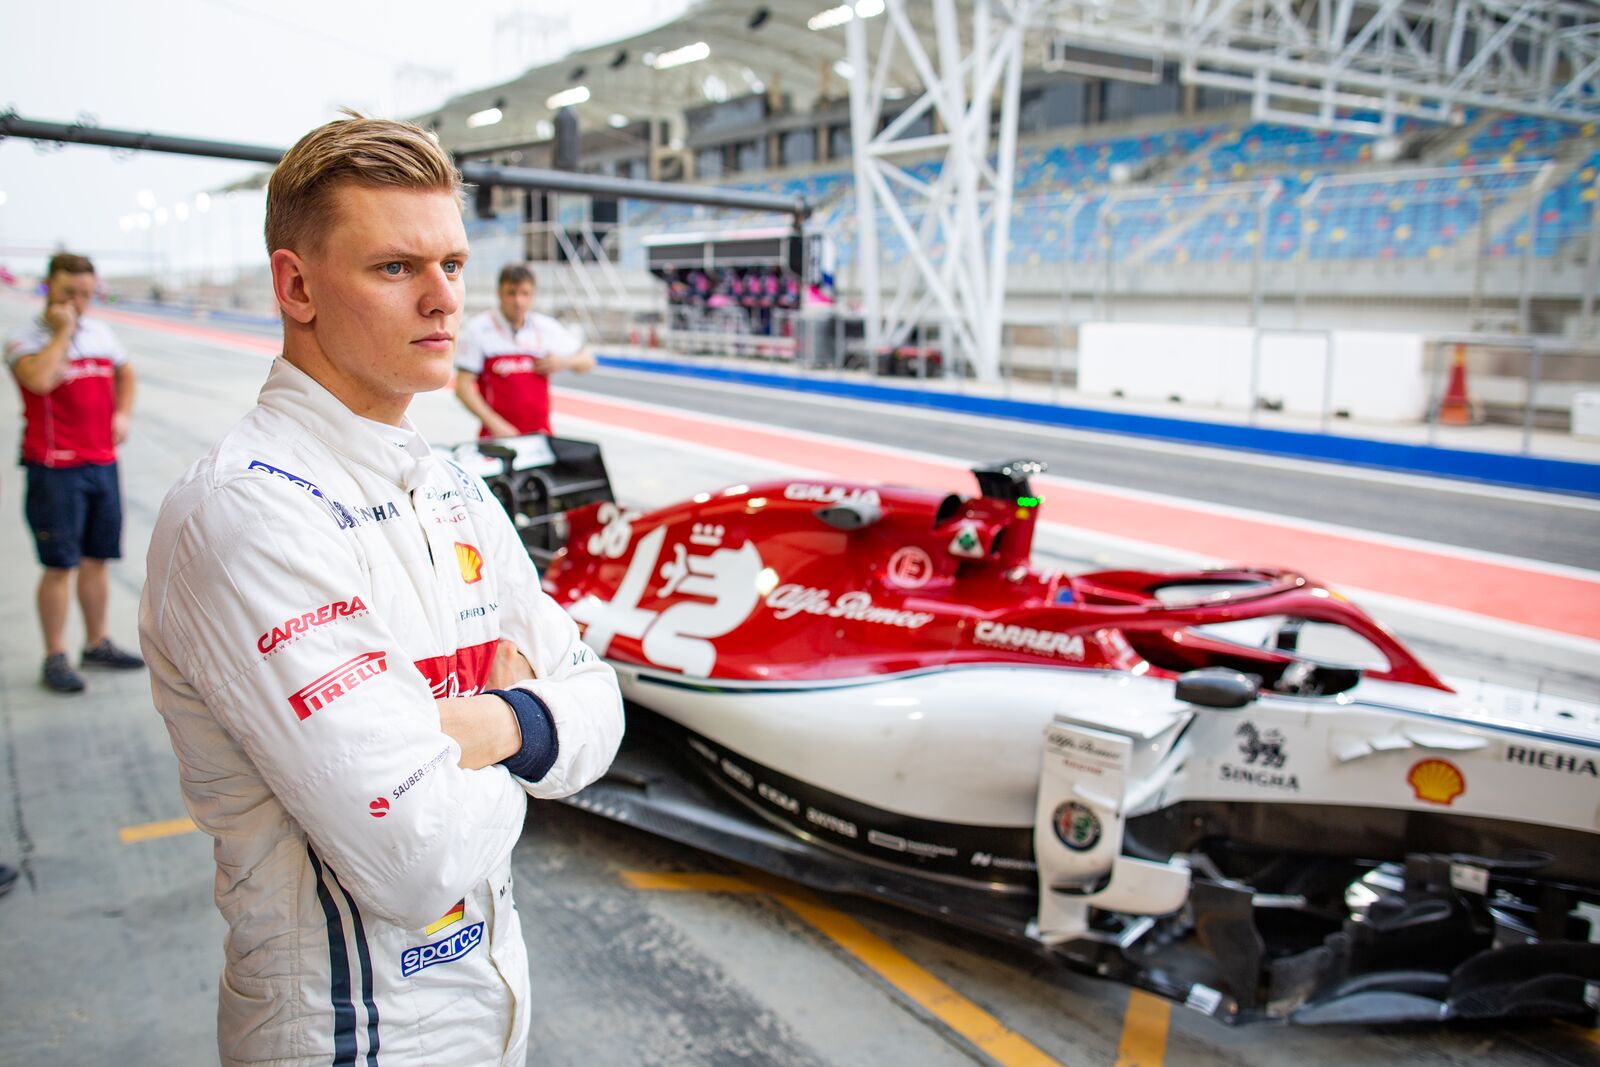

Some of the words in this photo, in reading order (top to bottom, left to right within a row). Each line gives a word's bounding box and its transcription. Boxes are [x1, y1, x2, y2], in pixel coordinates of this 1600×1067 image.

[784, 483, 880, 504] GIULIA
[766, 583, 830, 620] Alfa
[829, 591, 934, 628] Romeo
[257, 596, 368, 653] CARRERA
[974, 620, 1085, 657] CARRERA
[287, 651, 388, 721] PIRELLI
[1219, 764, 1299, 792] SINGHA
[1507, 745, 1600, 777] RICHA
[393, 768, 425, 800] SAUBER
[403, 923, 482, 969] sparco
